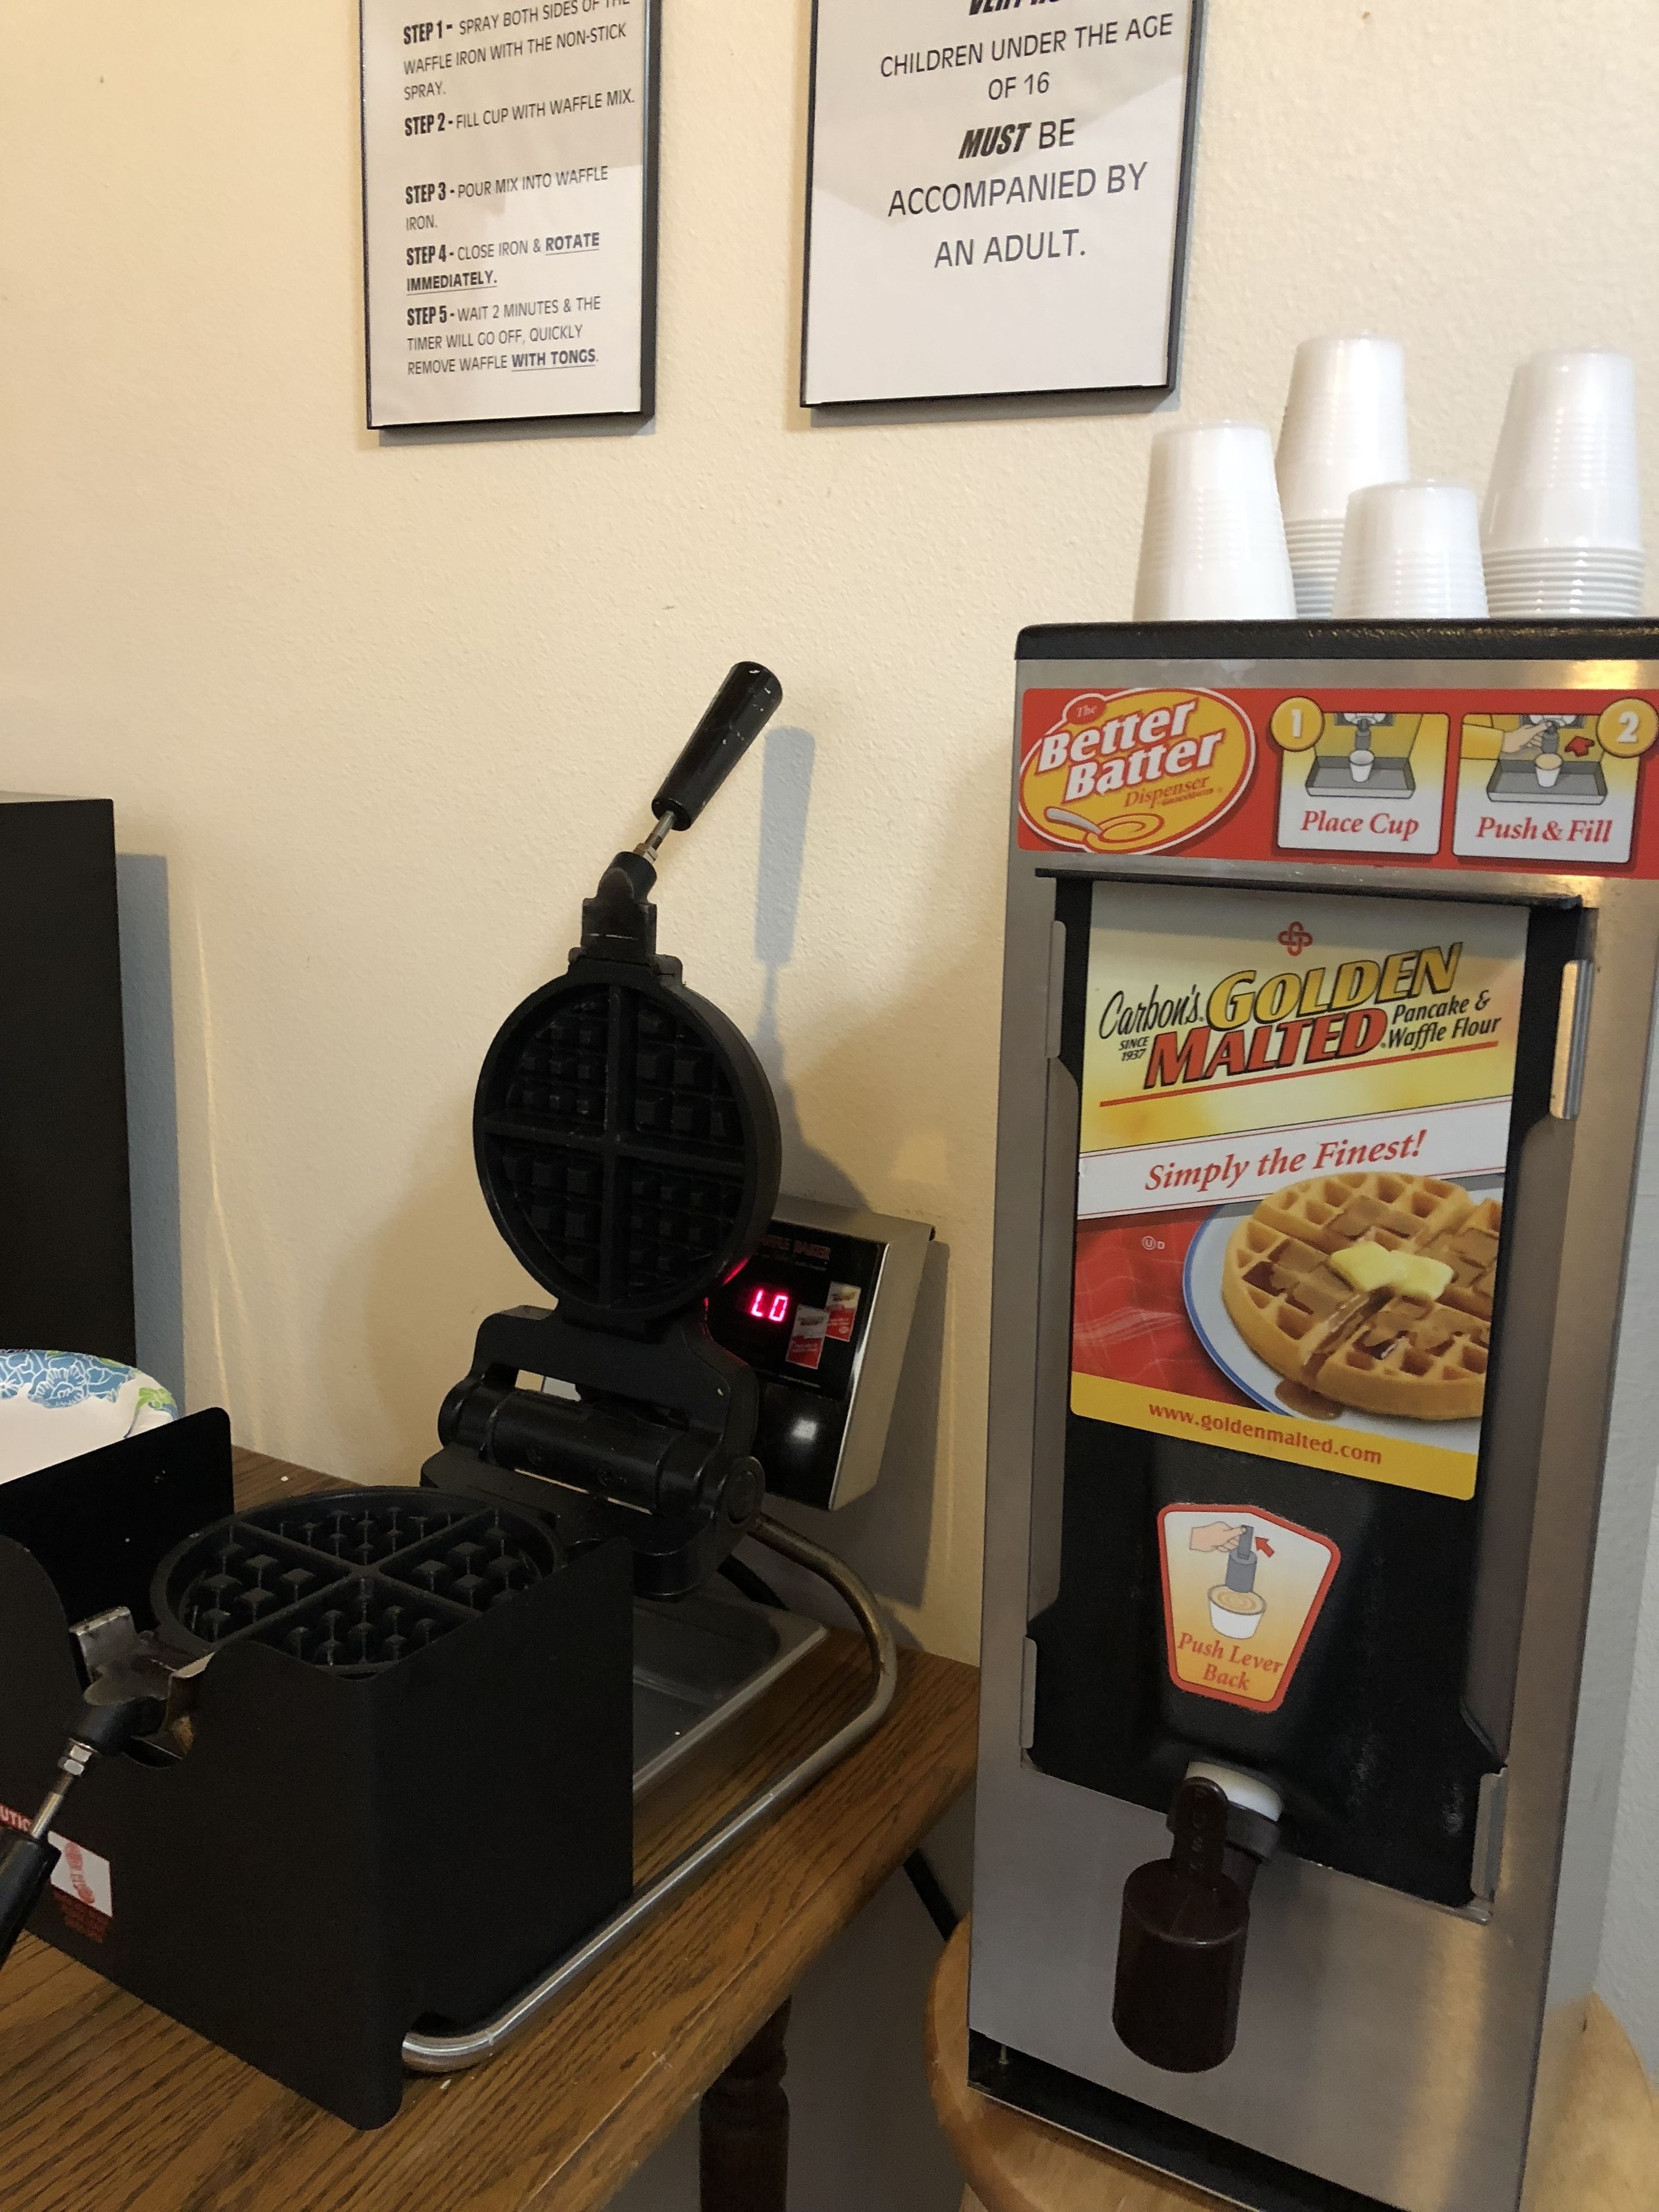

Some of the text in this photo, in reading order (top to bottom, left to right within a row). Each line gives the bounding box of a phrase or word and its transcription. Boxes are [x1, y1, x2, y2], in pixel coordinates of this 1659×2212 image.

[403, 21, 434, 46] STEP
[435, 20, 443, 39] 1
[459, 14, 499, 35] SPRAY
[503, 7, 539, 27] BOTH
[543, 0, 578, 20] SIDES
[582, 0, 600, 13] OF
[403, 22, 626, 75] WAFFLE IRON WITH THE NON-STICK
[880, 13, 1173, 78] CHILDREN UNDER THE AGE
[404, 81, 446, 101] SPRAY.
[988, 71, 1050, 101] OF 16
[404, 114, 435, 137] STEP
[437, 112, 446, 132] 2
[456, 112, 480, 129] FILL
[483, 107, 509, 125] CUP
[512, 102, 546, 120] WITH
[550, 93, 603, 115] WAFFLE
[607, 88, 635, 107] MIX.
[958, 118, 1075, 160] MUST BE
[405, 183, 435, 205] STEP
[437, 181, 446, 201] 3
[457, 180, 492, 198] POUR
[495, 177, 518, 194] MIX
[522, 172, 552, 190] INTO
[555, 165, 609, 186] WAFFLE
[887, 161, 1148, 217] ACCOMPANIED BY
[406, 215, 437, 230] IRON.
[406, 245, 436, 266] STEP
[438, 244, 448, 263] 4
[457, 243, 495, 261] CLOSE
[499, 240, 528, 256] IRON
[532, 238, 541, 253] &
[546, 232, 600, 252] ROTATE
[934, 228, 1086, 268] AN ADULT.
[407, 270, 498, 292] IMMEDIATELY.
[407, 306, 437, 327] STEP
[438, 305, 448, 324] 5
[457, 305, 489, 322] WAIT
[492, 304, 499, 319] 2
[503, 299, 559, 317] MINUTES
[563, 298, 571, 313] &
[575, 296, 601, 311] THE
[407, 324, 583, 351] TIMER WILL GO OFF, QUICKLY
[408, 348, 599, 375] REMOVE WAFFLE WITH TONGS.
[1076, 704, 1097, 717] The
[1290, 709, 1302, 737] 1
[1616, 711, 1641, 743] 2
[1036, 698, 1198, 774] Better
[1062, 729, 1225, 803] Batter
[1124, 775, 1211, 808] Dispenser
[1301, 810, 1419, 841] Place Cup
[1476, 816, 1613, 843] Push & Fill
[1099, 942, 1463, 1039] Carbon's GOLDEN
[1392, 990, 1491, 1025] Pancake &
[1119, 1037, 1149, 1051] SINCE
[1143, 1007, 1388, 1089] MALTED
[1388, 1014, 1502, 1053] Waffle Flour
[1122, 1048, 1146, 1061] 1937
[1145, 1130, 1427, 1193] Simply the Finest!
[1149, 1403, 1382, 1465] www.goldenmalted.com
[1178, 1633, 1284, 1673] Push Lever
[1203, 1664, 1250, 1691] Back
